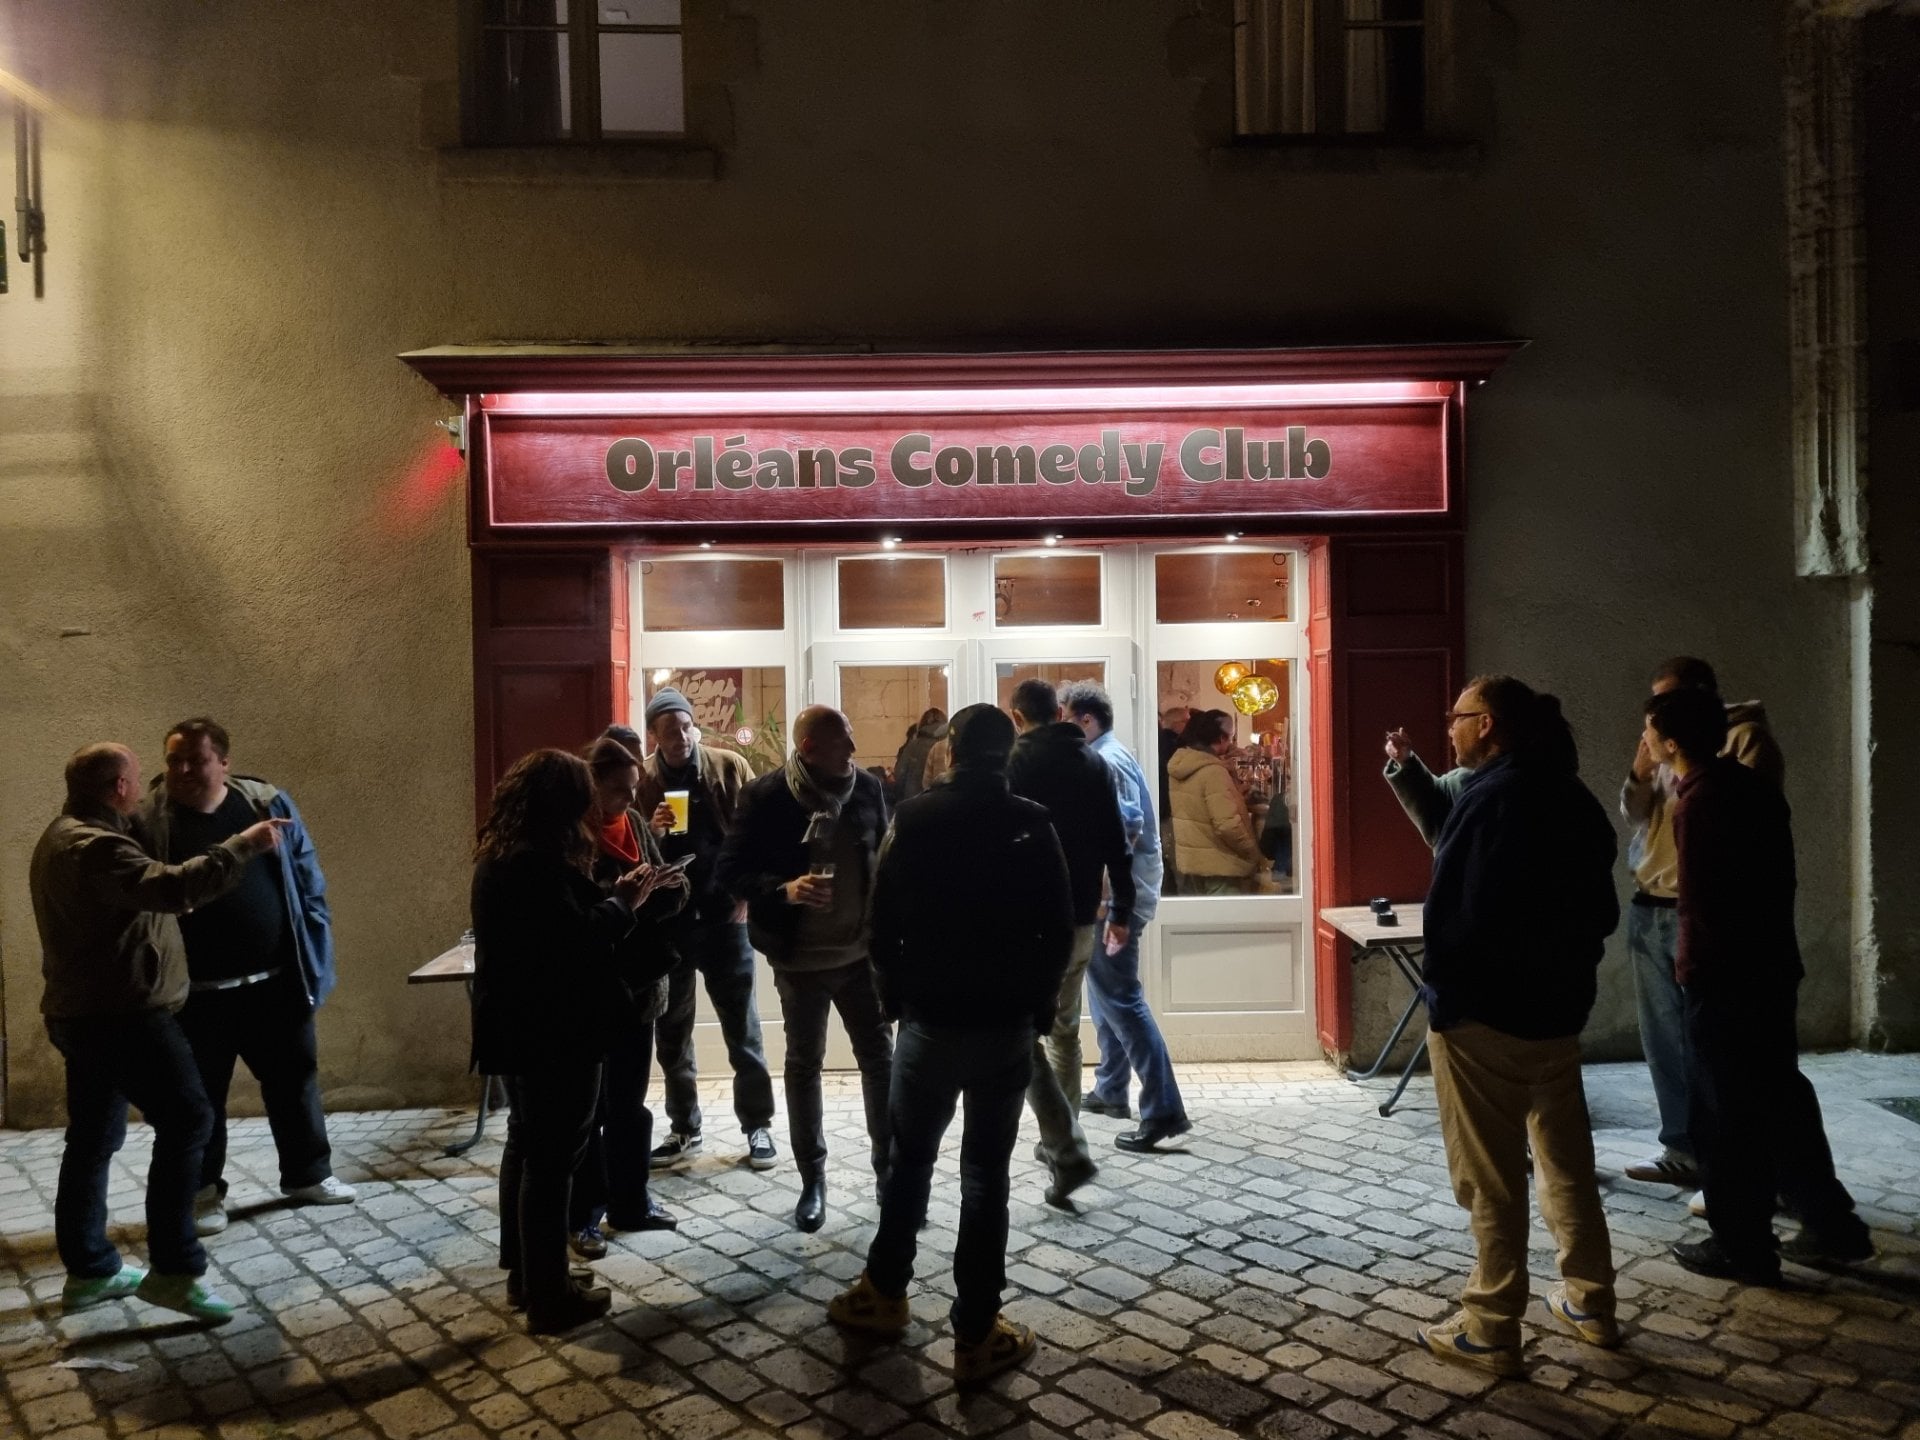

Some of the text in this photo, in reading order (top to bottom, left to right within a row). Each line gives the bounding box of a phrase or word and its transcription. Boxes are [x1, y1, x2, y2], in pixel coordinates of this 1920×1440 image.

[605, 425, 1333, 497] Orléans Comedy Club
